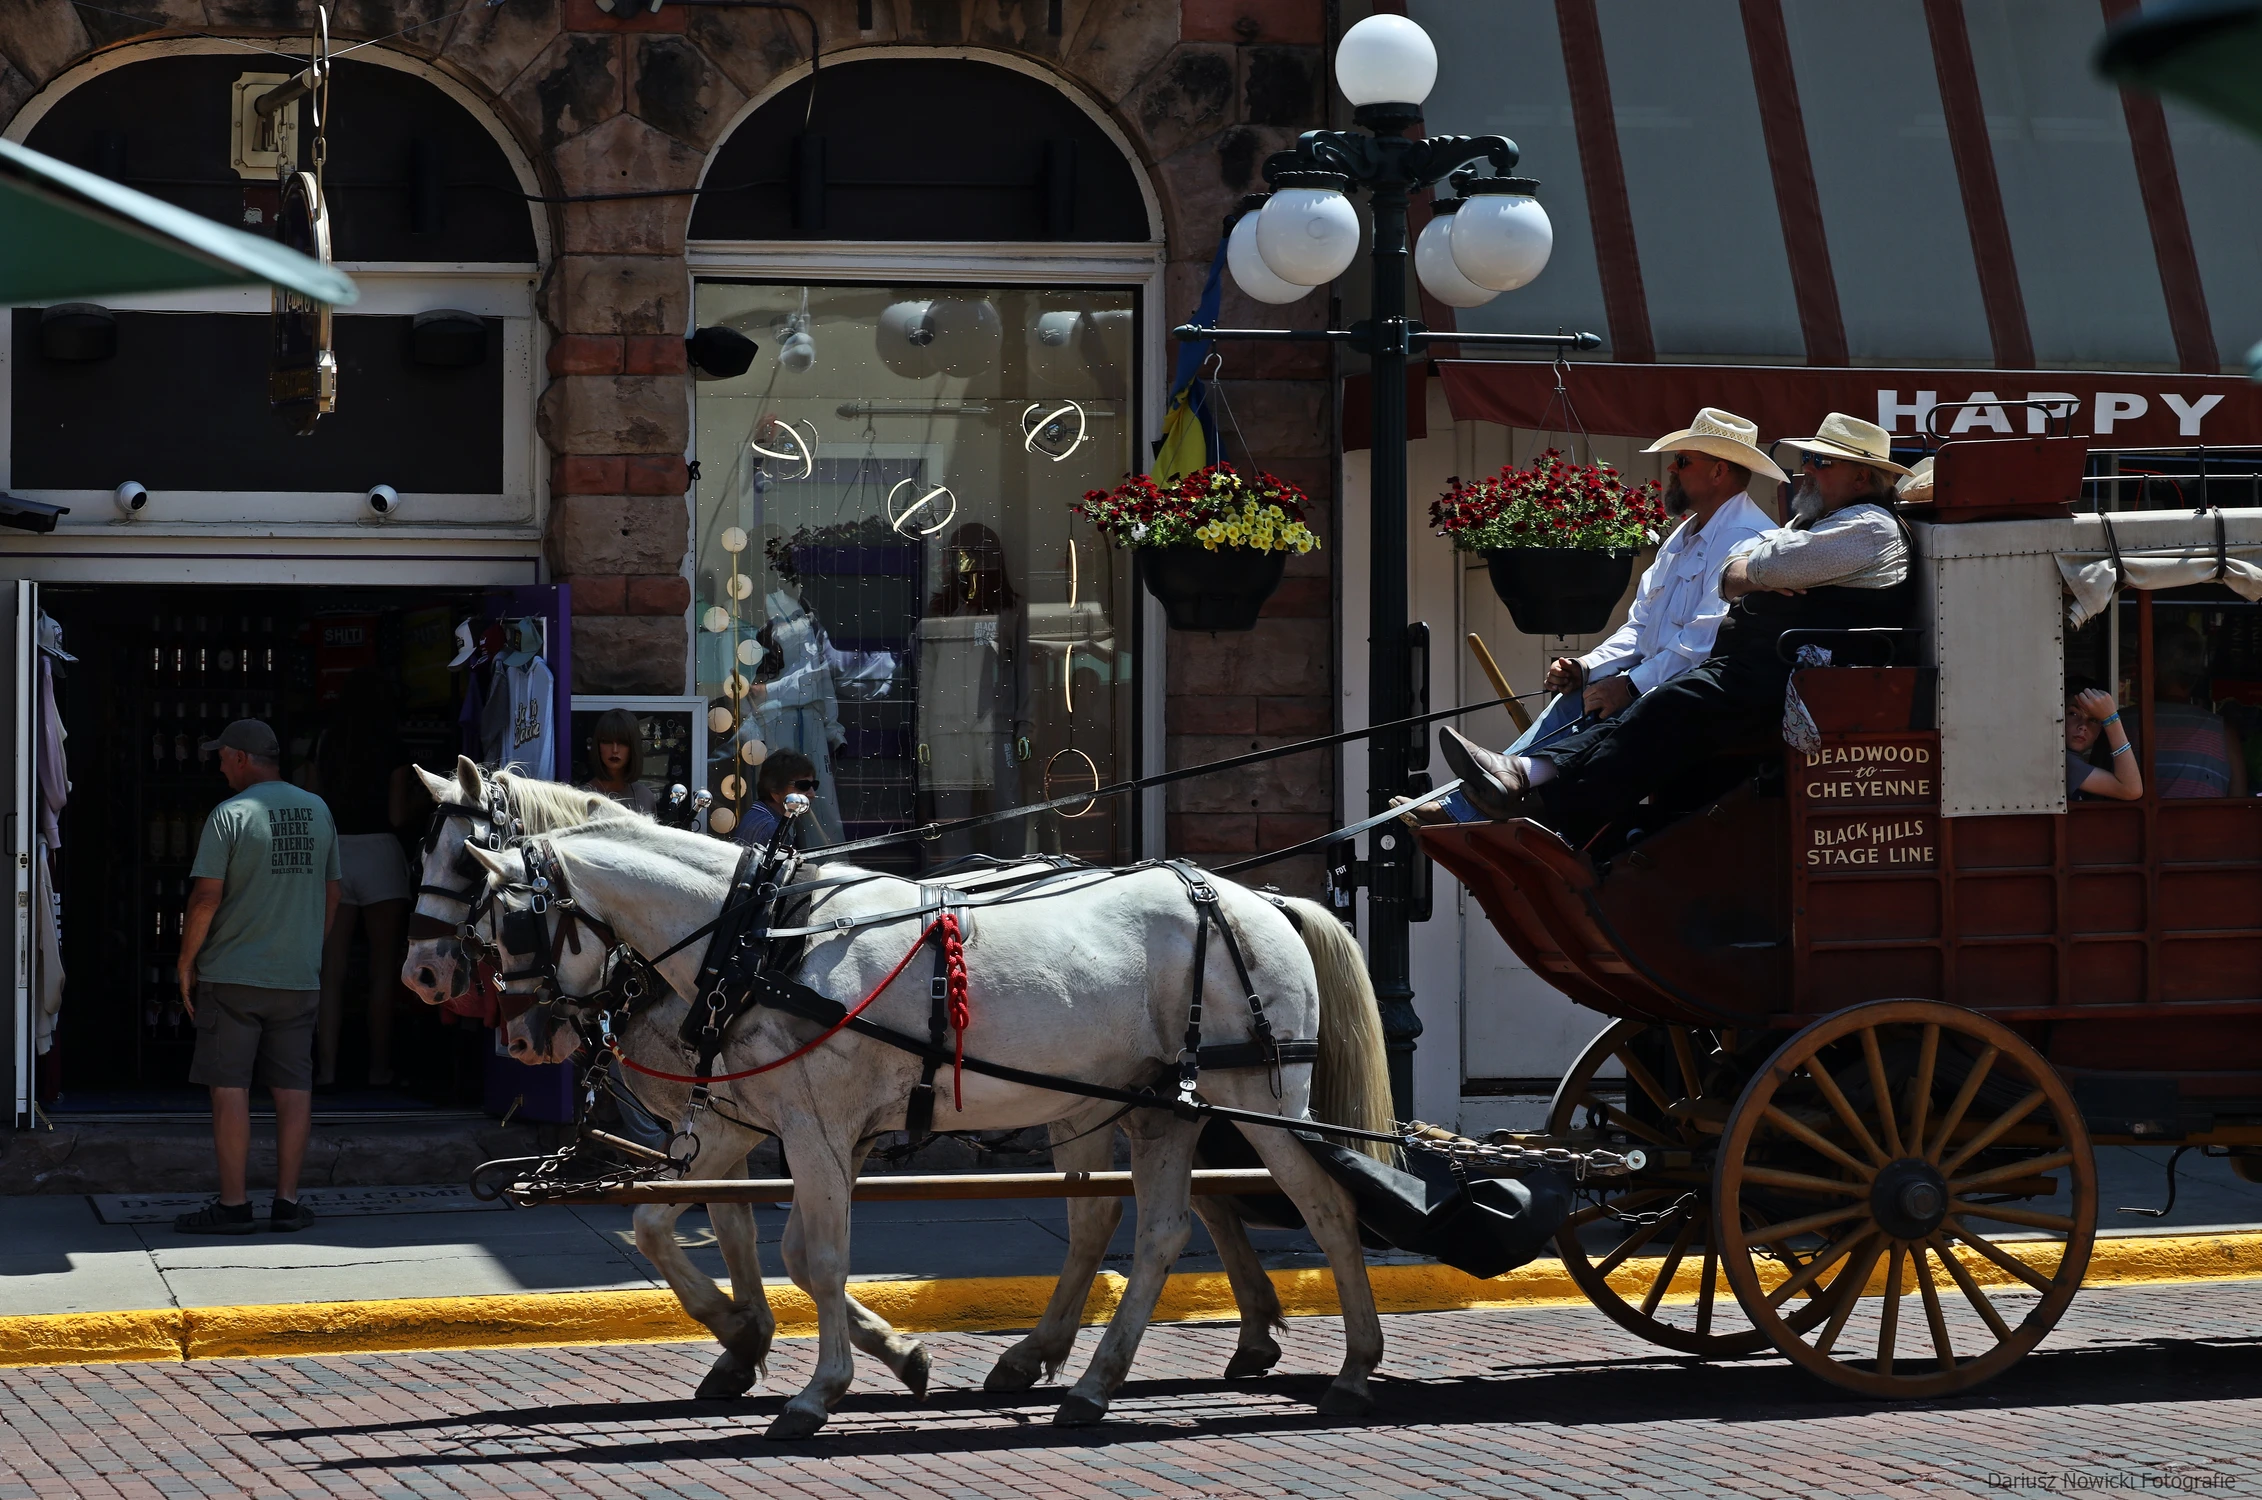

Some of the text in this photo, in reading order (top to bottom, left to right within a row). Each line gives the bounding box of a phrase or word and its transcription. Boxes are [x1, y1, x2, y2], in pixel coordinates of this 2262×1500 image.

[1877, 389, 2225, 436] HAPPY
[1806, 746, 1930, 767] DEADWOOD
[1855, 766, 1878, 778] to
[1806, 780, 1930, 798] CHEYENNE
[268, 808, 313, 822] A PLACE
[270, 822, 308, 837] WHERE
[1814, 820, 1924, 846] BLACK HILLS
[272, 837, 314, 852] FRIENDS
[1807, 847, 1934, 865] STAGE LINE
